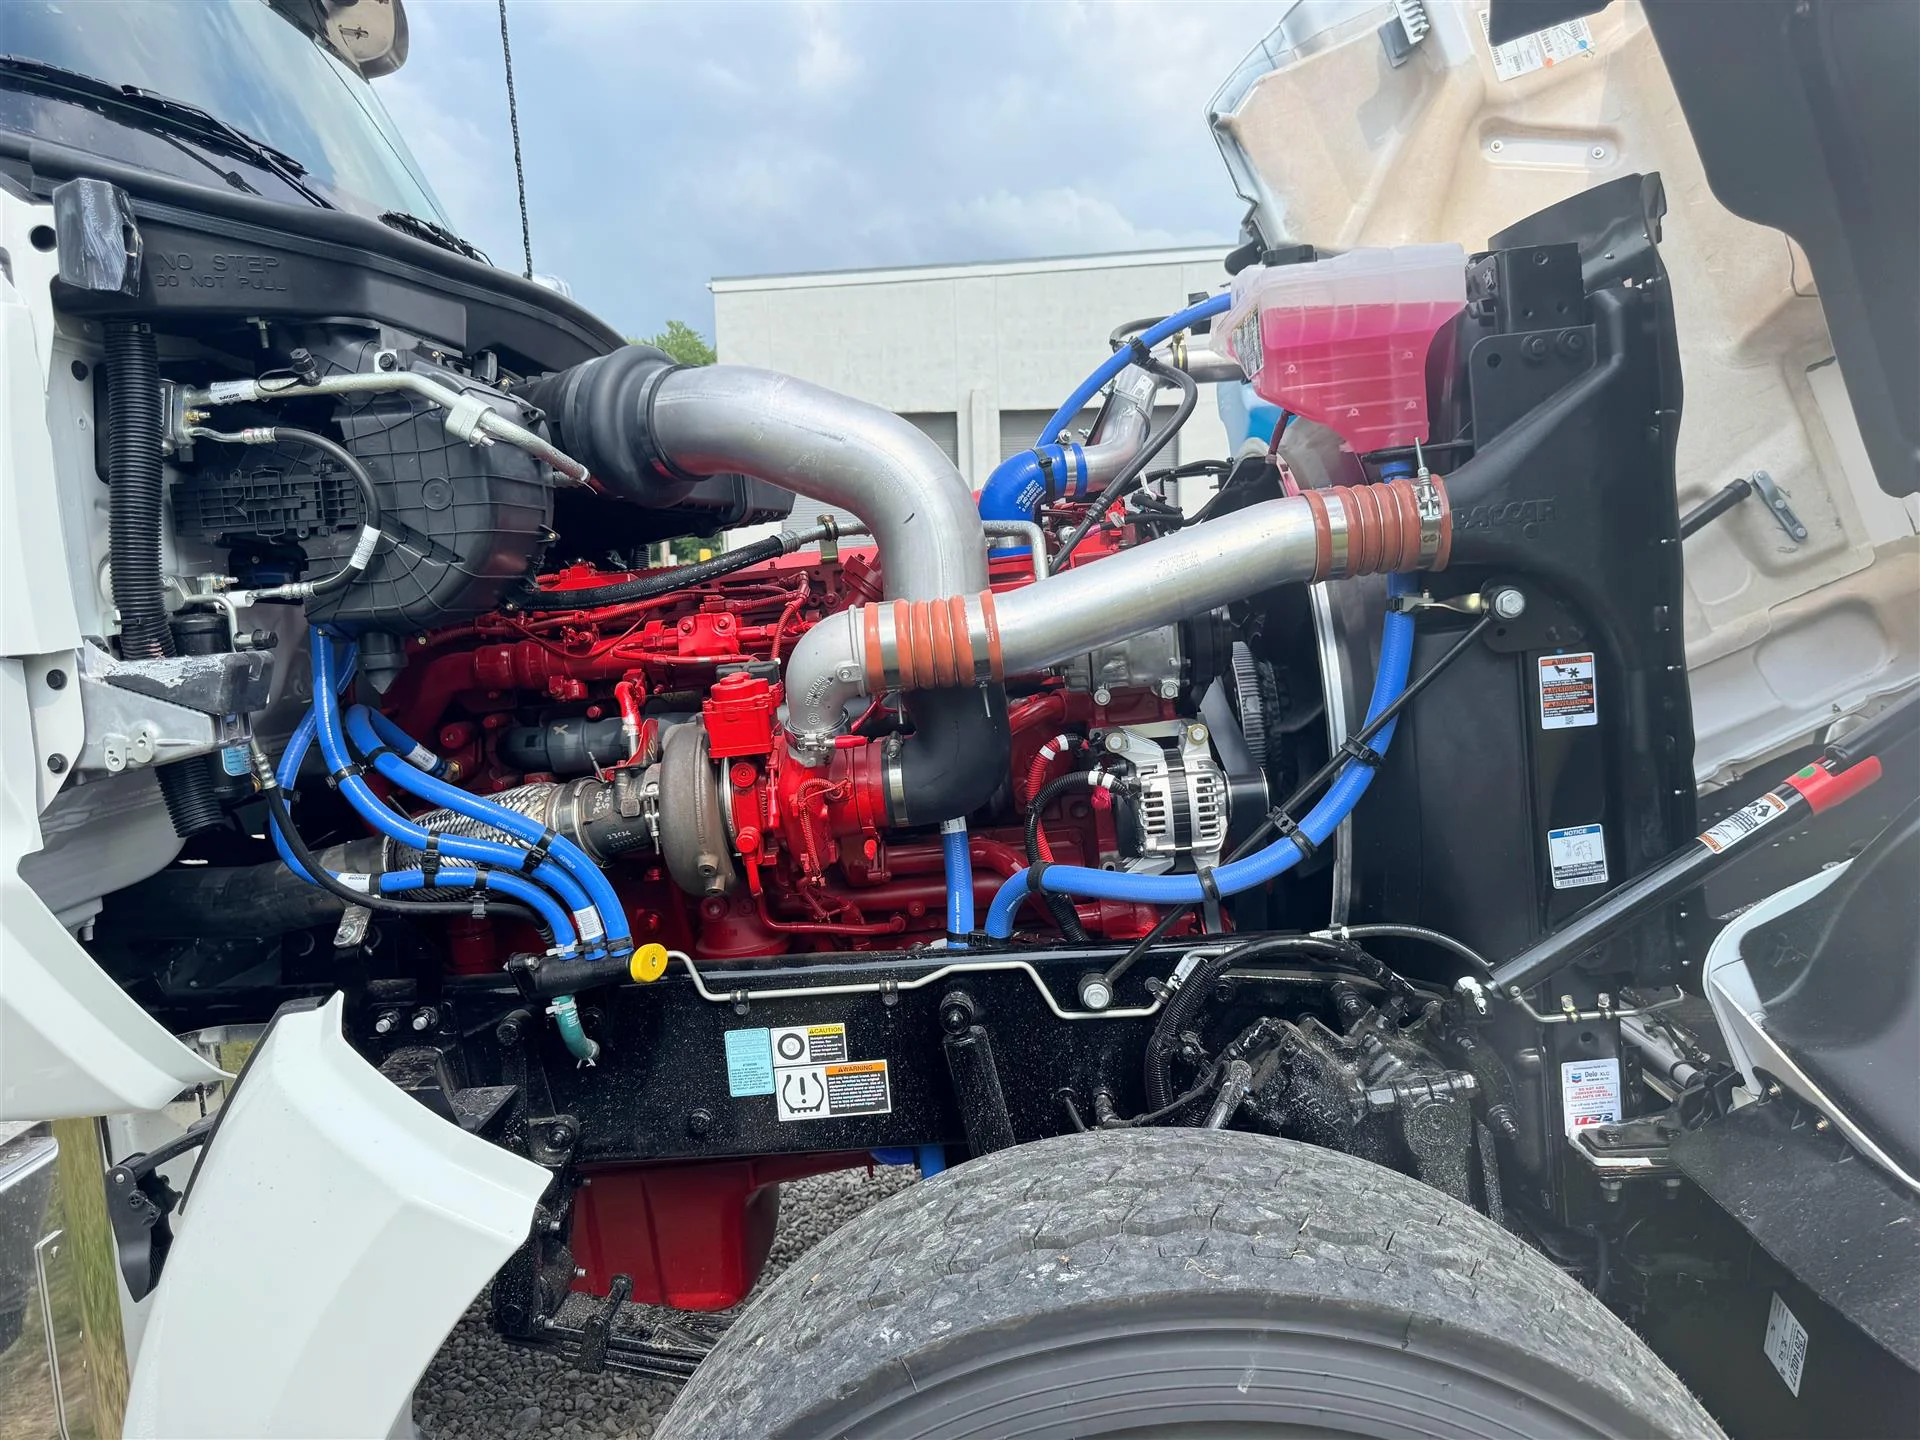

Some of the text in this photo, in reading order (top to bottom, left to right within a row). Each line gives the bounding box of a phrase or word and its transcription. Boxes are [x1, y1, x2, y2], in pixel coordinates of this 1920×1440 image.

[160, 253, 280, 274] NO STEP
[156, 274, 287, 291] DO NOT PULL
